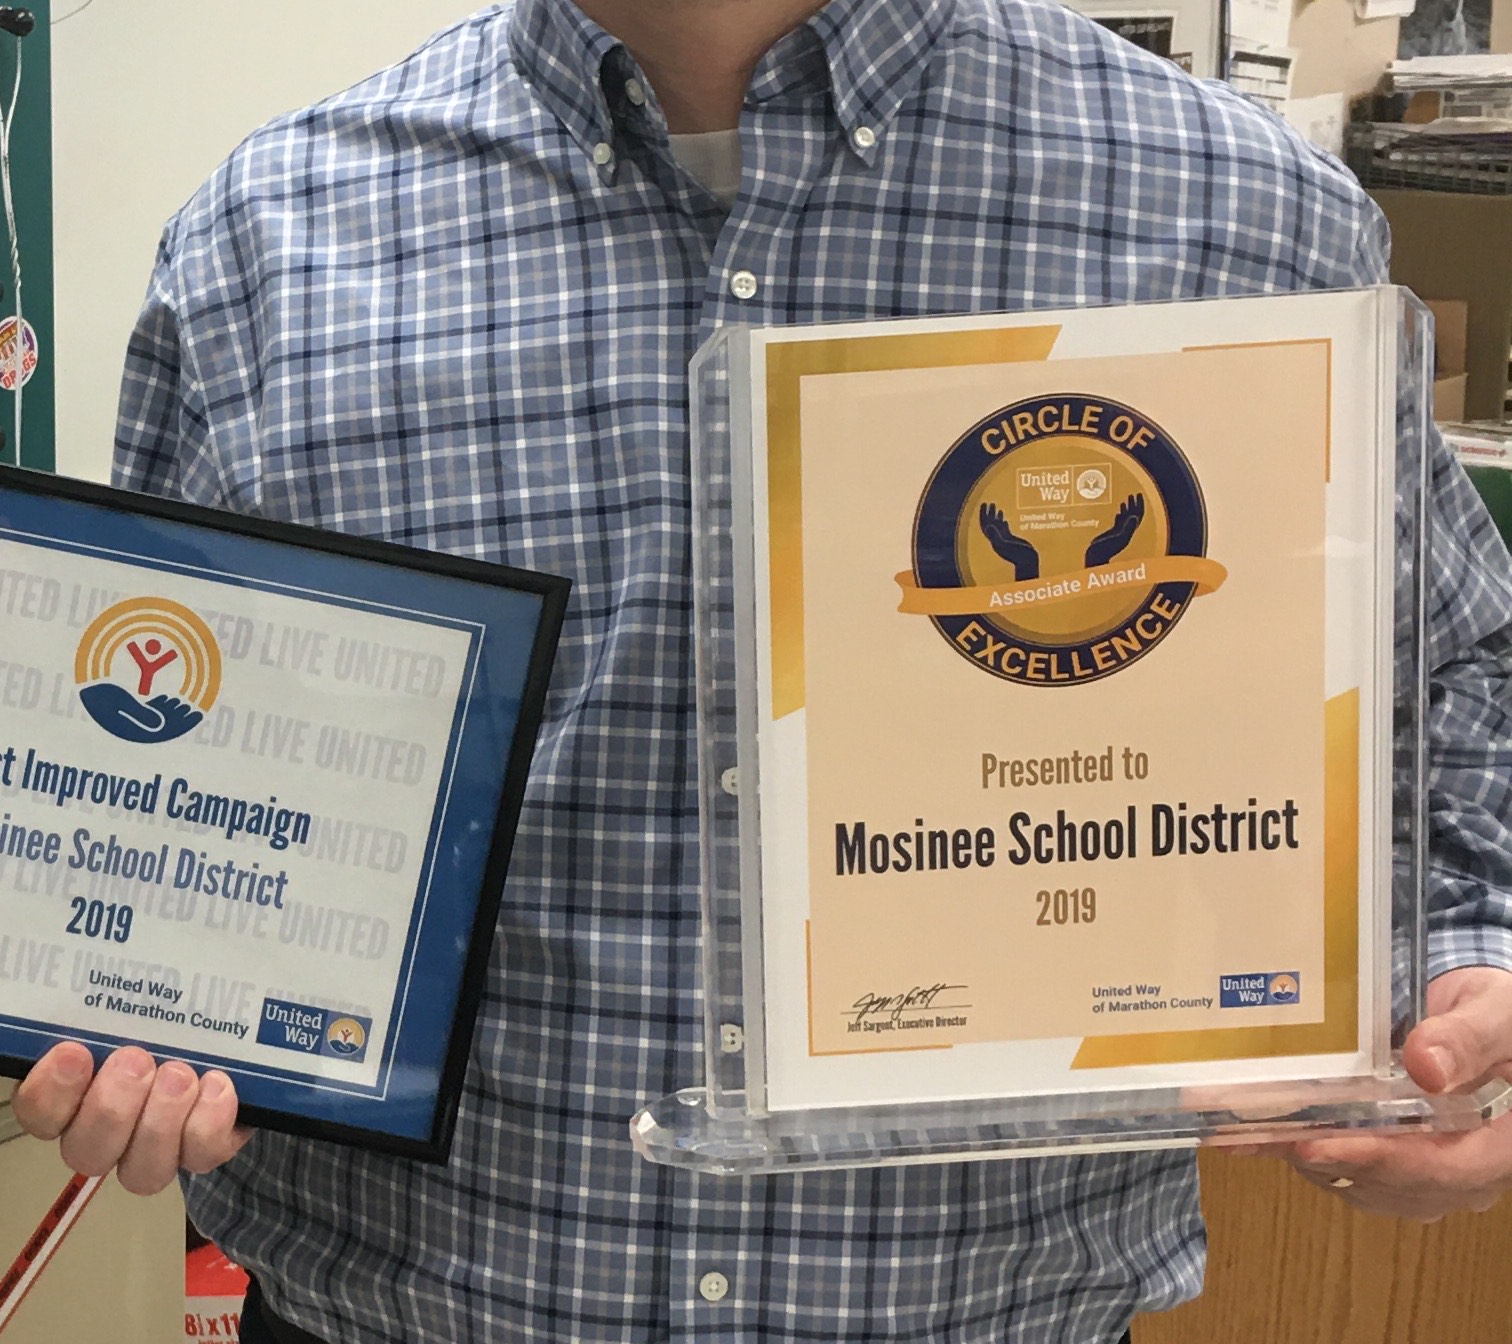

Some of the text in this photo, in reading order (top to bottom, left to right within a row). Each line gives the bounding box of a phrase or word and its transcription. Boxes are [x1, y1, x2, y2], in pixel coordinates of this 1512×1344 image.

[981, 404, 1156, 455] CIRCLE OF
[1020, 470, 1070, 487] United
[1039, 486, 1070, 504] Way
[1019, 511, 1065, 522] United Way
[1070, 518, 1100, 528] County
[989, 563, 1147, 608] Associate Award
[955, 592, 1181, 681] EXCELLENCE
[259, 622, 330, 677] LIVE
[333, 636, 447, 699] UNITED
[240, 709, 311, 765] LIVE
[314, 724, 428, 788] UNITED
[982, 746, 1150, 789] Presented to
[21, 748, 162, 815] Improved
[166, 777, 312, 851] Campaign
[296, 813, 409, 875] UNITED
[835, 797, 1299, 876] Mosinee School District
[67, 828, 169, 885] School
[173, 847, 289, 910] District
[65, 895, 134, 944] 2019
[1035, 887, 1097, 926] 2019
[278, 899, 391, 962] UNITED
[89, 969, 184, 1004] United Way
[1092, 984, 1161, 998] United Way
[1222, 976, 1265, 991] United
[1239, 990, 1265, 1004] Way
[84, 993, 250, 1040] of Marathon County
[265, 1003, 323, 1030] United
[847, 1020, 862, 1033] Jeff
[897, 1017, 934, 1030] Executive
[935, 1016, 968, 1027] Director
[1092, 997, 1214, 1013] of Marathon County
[284, 1025, 320, 1051] Way
